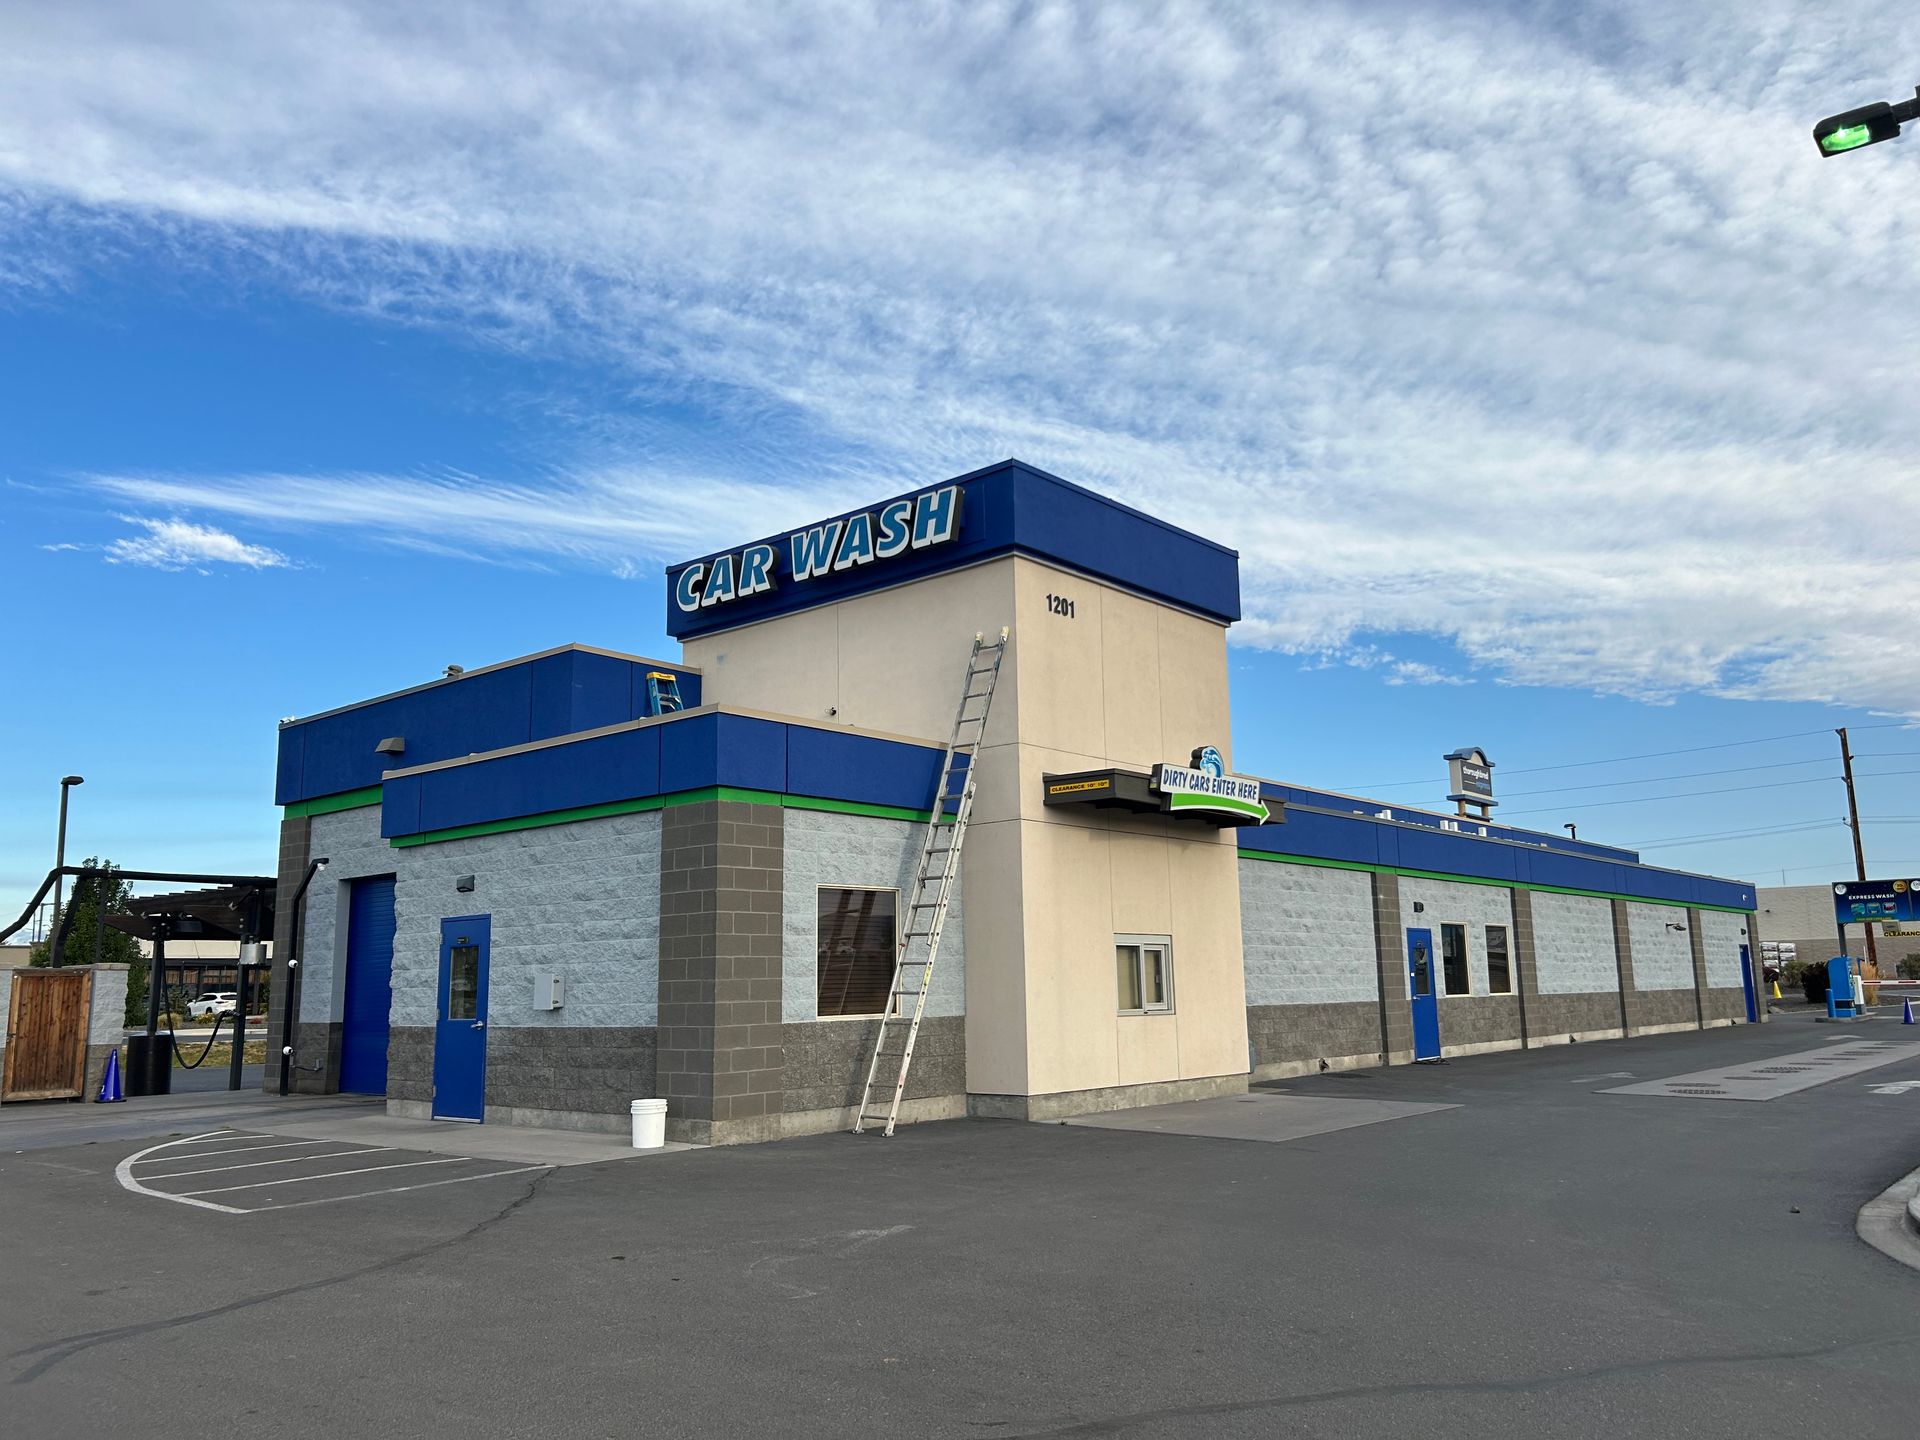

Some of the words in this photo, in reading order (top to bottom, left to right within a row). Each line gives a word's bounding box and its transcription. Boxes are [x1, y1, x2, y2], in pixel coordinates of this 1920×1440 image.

[676, 544, 777, 612] CAR
[790, 485, 961, 582] WASH
[1046, 593, 1075, 619] 1201
[1051, 784, 1085, 792] CLEARANCE
[1163, 768, 1189, 789] DIRTY
[1189, 773, 1210, 793] CARS
[1212, 778, 1236, 796] ENTER
[1238, 782, 1258, 800] HERE
